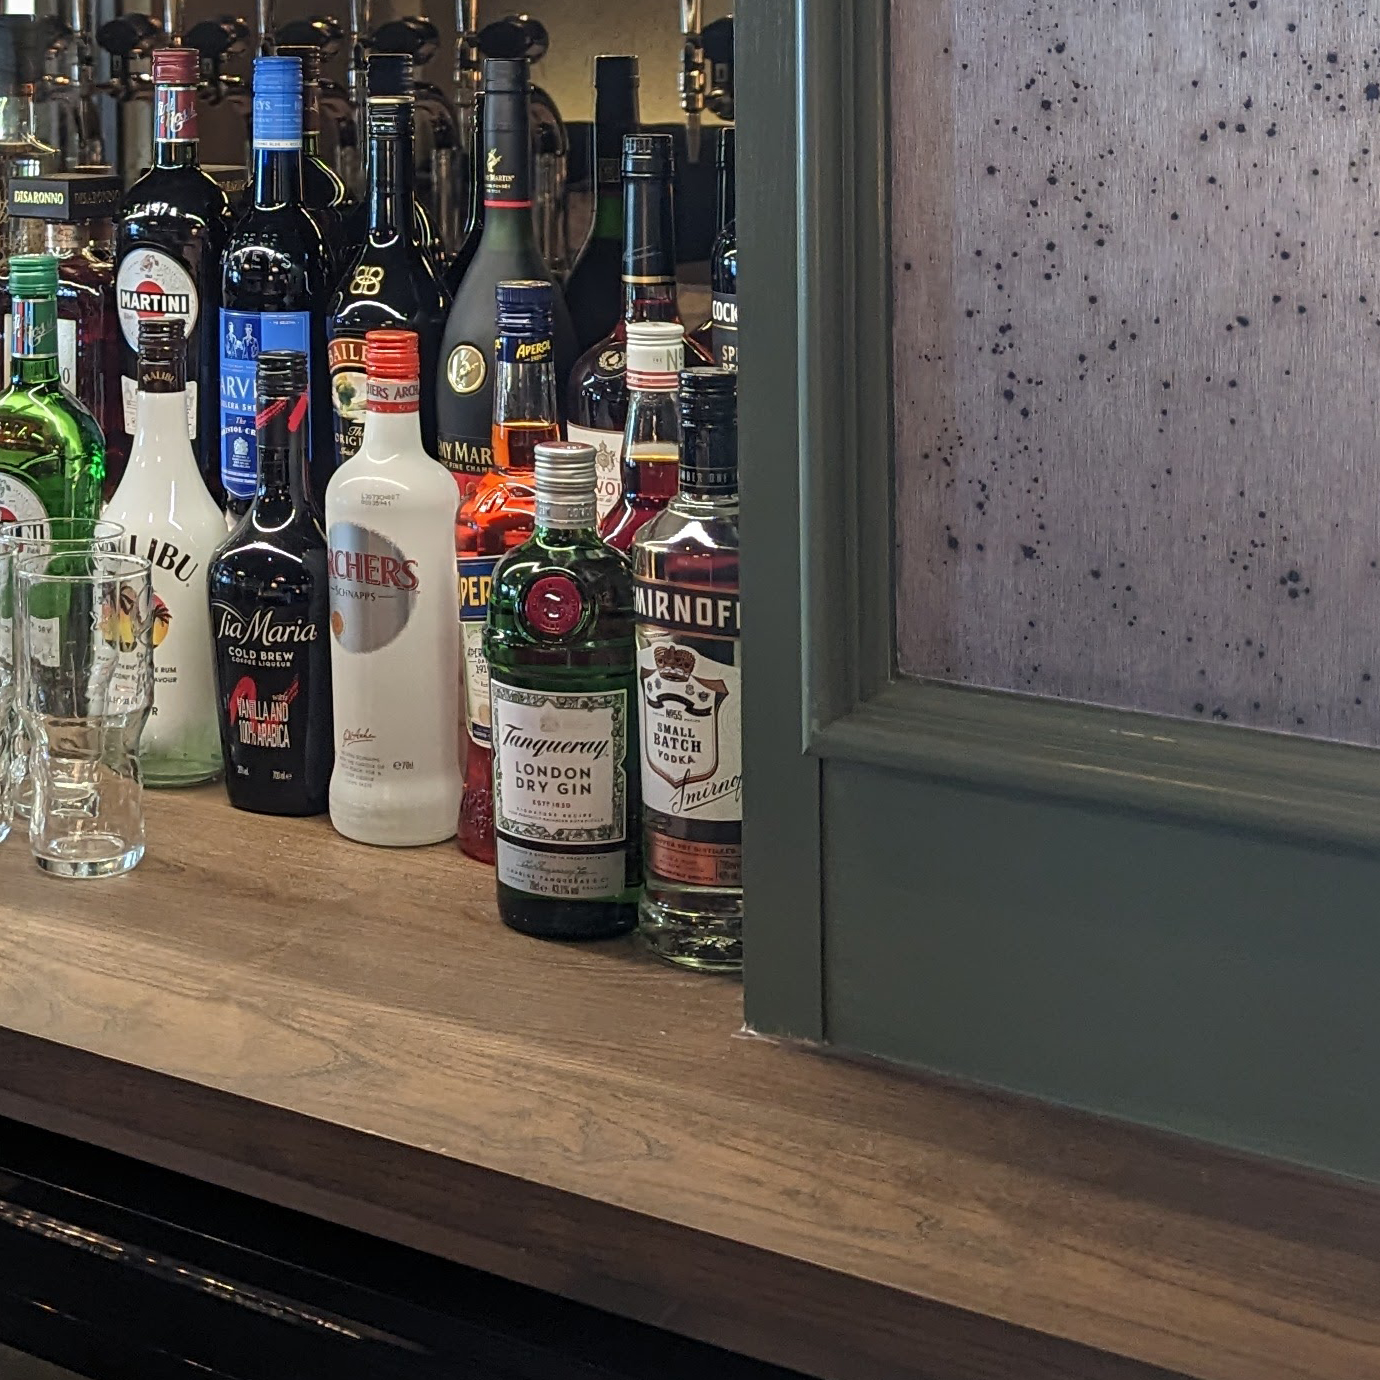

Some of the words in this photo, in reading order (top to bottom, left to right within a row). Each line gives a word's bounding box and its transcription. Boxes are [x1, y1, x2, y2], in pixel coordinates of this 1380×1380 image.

[14, 190, 64, 205] DISARONNO
[120, 290, 187, 313] MARTINI
[516, 340, 551, 359] APEROL
[455, 441, 493, 466] MAR
[335, 586, 376, 601] SCHNAPPS
[218, 608, 243, 640] Tia
[239, 609, 317, 646] Maria
[228, 646, 257, 659] COLD
[260, 651, 294, 661] BREW
[232, 656, 256, 665] COFFEE
[236, 697, 269, 721] VANILLA
[270, 701, 289, 722] AND
[238, 719, 257, 746] 100%
[257, 722, 291, 748] ARABICA
[657, 722, 696, 738] SMALL
[501, 723, 608, 760] Tanqueray
[653, 733, 701, 753] BATCH
[657, 749, 697, 764] VODKA
[515, 761, 591, 779] LONDON
[516, 777, 548, 793] DRY
[557, 783, 592, 795] GIN
